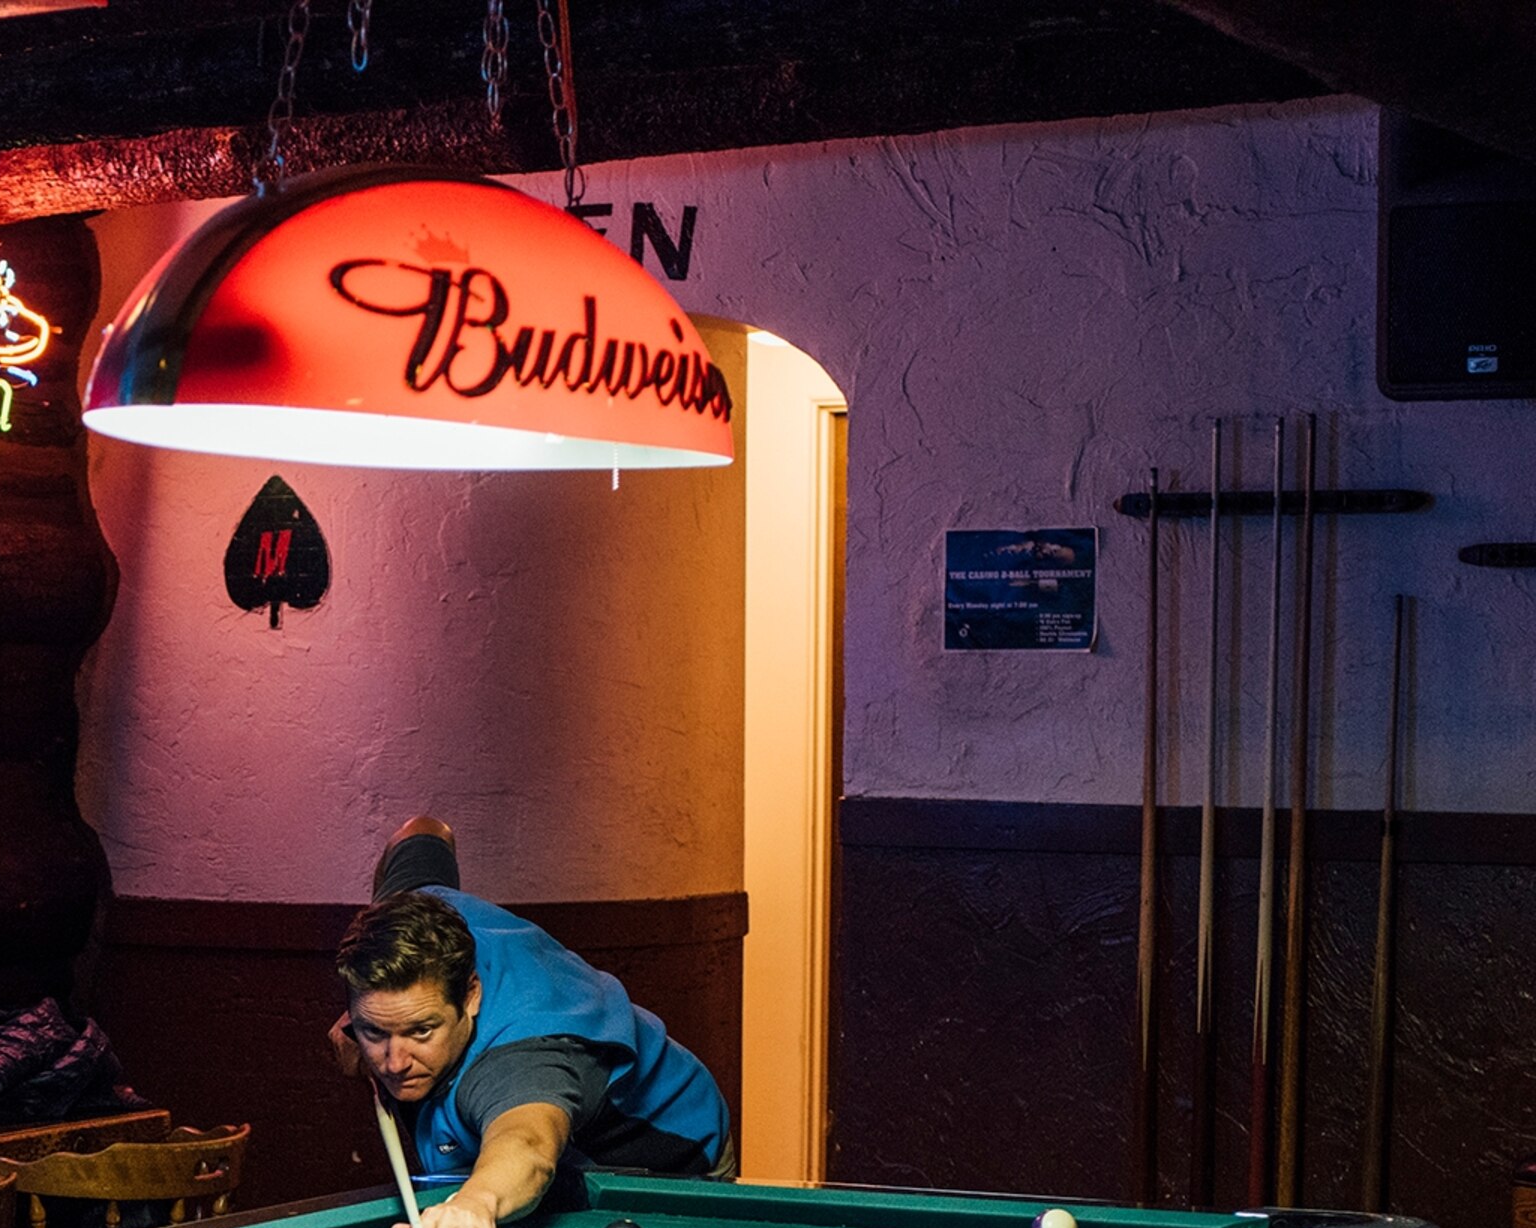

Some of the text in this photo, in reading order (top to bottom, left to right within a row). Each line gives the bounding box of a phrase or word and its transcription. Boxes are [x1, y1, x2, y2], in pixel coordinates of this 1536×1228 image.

[254, 529, 293, 580] M
[949, 571, 966, 580] THE
[968, 570, 999, 580] CASINO
[1032, 569, 1092, 579] TOURNAMENT
